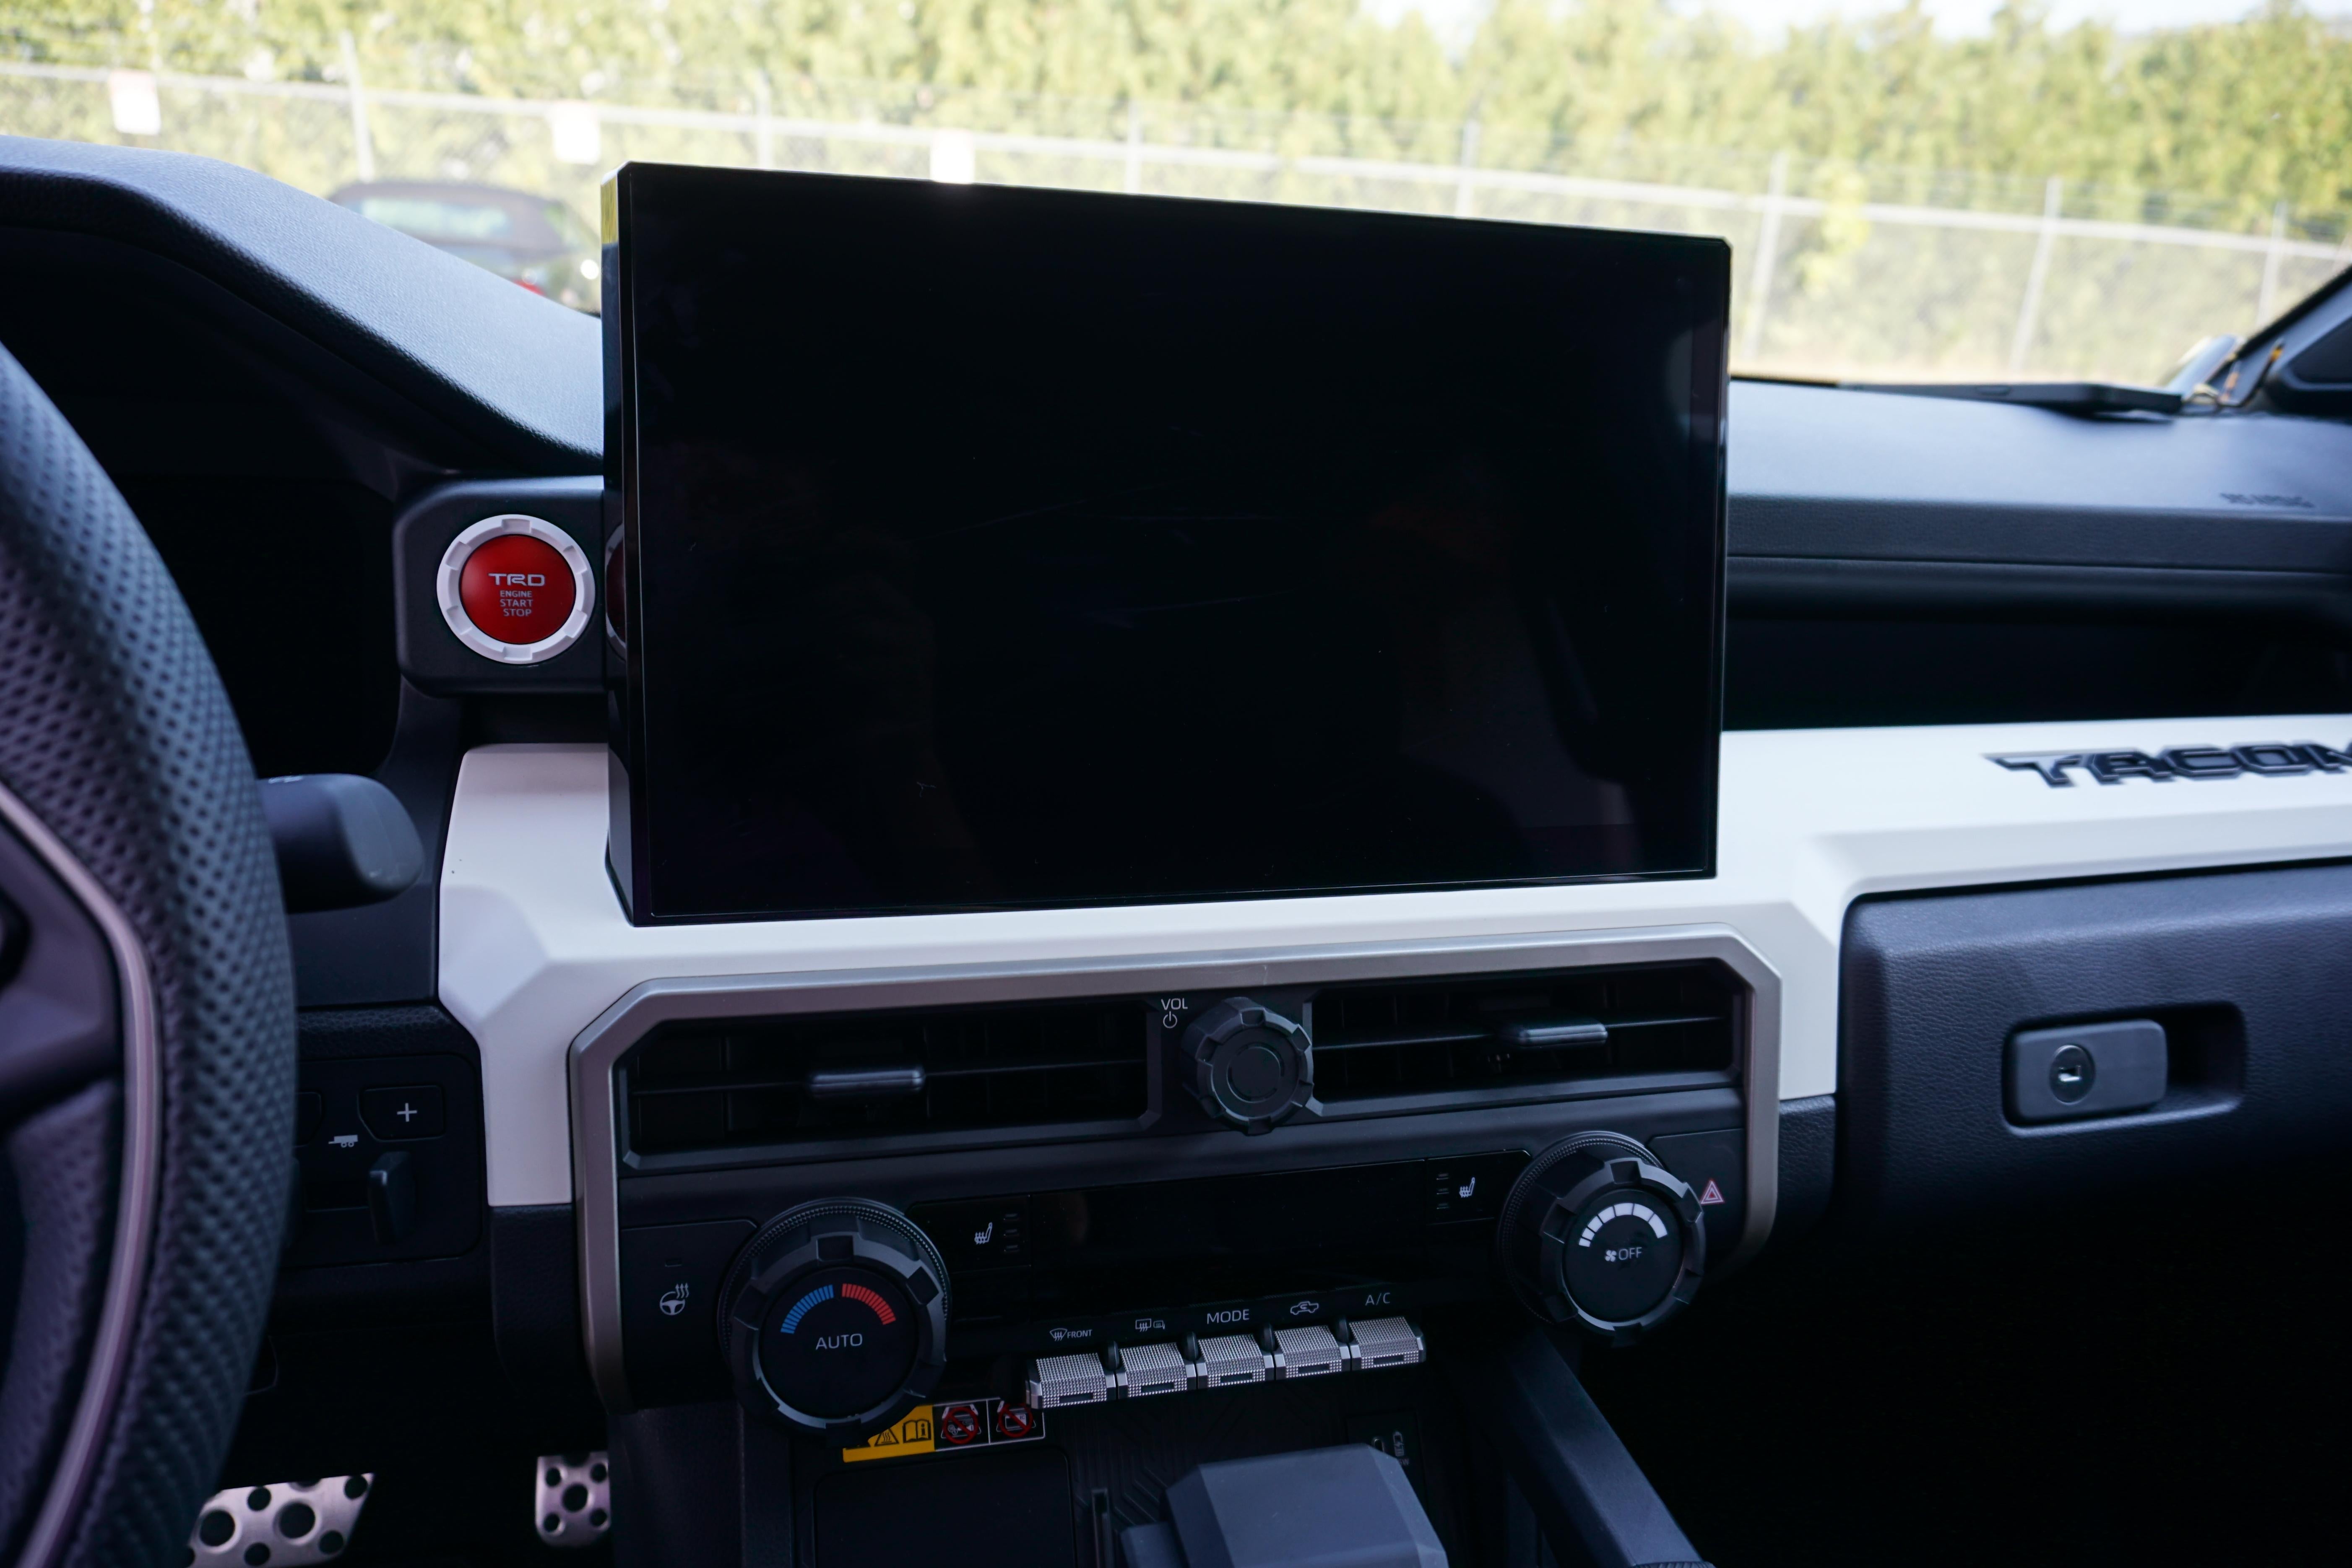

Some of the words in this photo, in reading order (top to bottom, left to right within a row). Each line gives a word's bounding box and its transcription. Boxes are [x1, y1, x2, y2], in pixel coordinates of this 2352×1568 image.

[488, 572, 545, 586] TRD
[500, 599, 533, 608] START
[1161, 998, 1188, 1011] VOL
[1618, 1246, 1643, 1260] OFF
[1365, 1292, 1391, 1306] A/C
[1206, 1308, 1250, 1324] MODE
[1067, 1329, 1093, 1339] FRONT
[815, 1333, 863, 1350] AUTO
